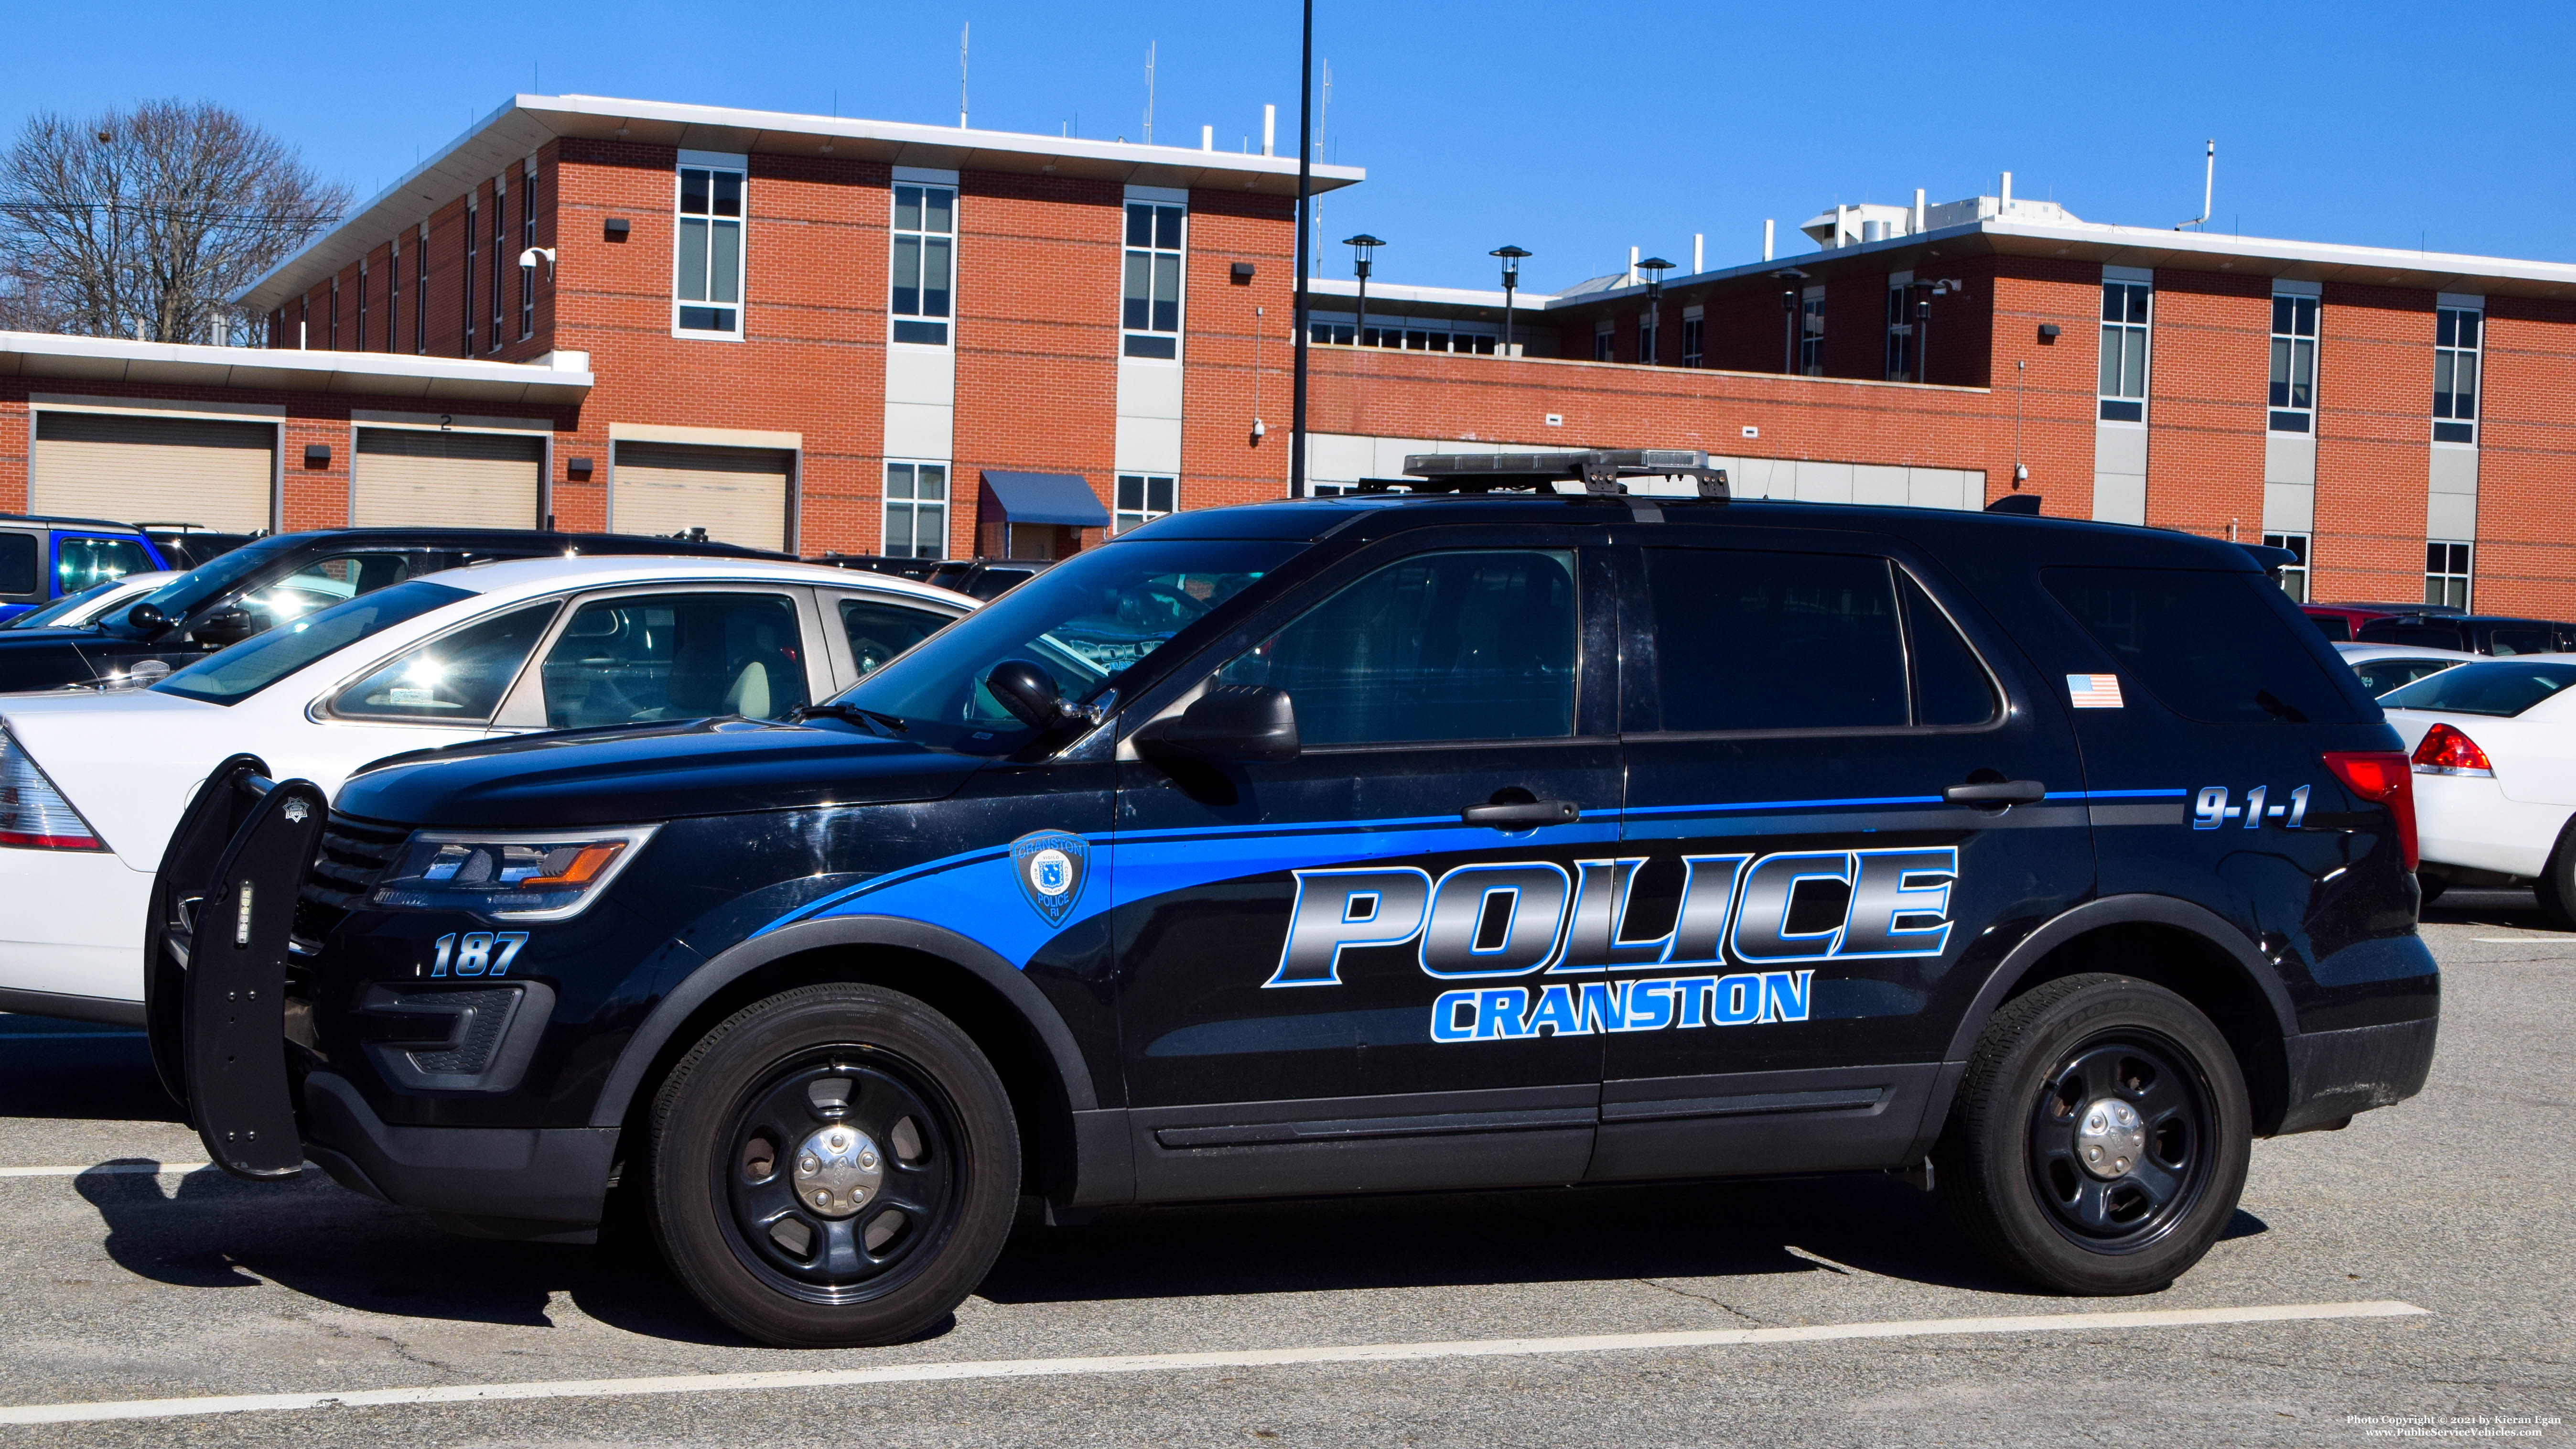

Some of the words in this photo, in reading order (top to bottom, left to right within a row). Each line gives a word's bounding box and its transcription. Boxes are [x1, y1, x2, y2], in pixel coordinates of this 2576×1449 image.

[440, 414, 452, 431] 2
[2193, 785, 2310, 830] 9-1-1
[1018, 838, 1082, 859] CRANSTON
[1037, 891, 1069, 907] POLICE
[1051, 908, 1059, 917] RI
[1261, 846, 1958, 989] POLICE
[431, 931, 529, 976] 187
[1431, 969, 1815, 1044] CRANSTON
